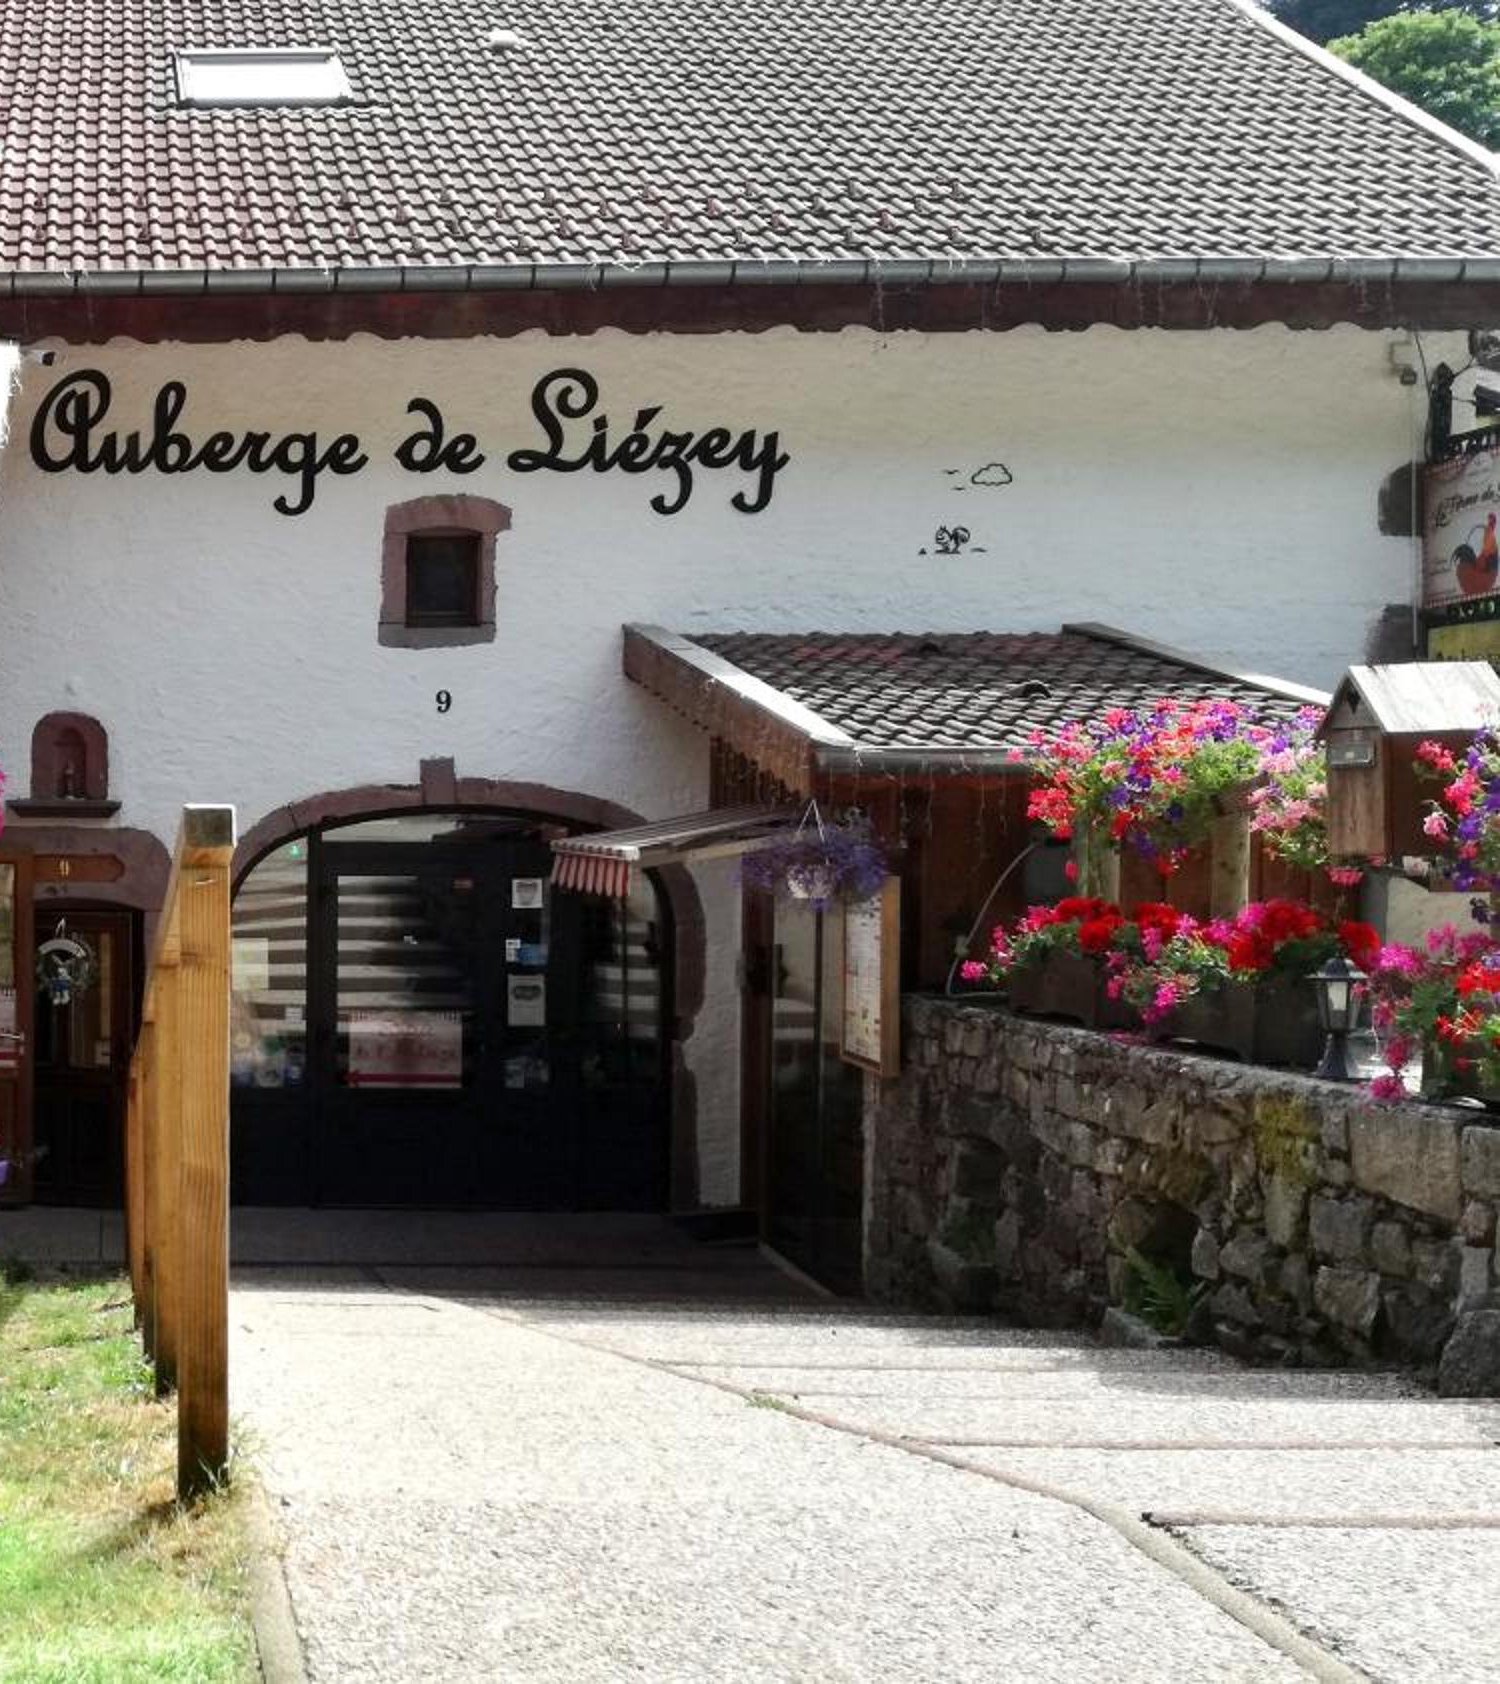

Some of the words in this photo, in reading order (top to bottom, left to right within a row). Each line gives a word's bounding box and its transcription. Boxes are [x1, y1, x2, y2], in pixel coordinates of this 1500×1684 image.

[30, 369, 368, 516] Auberge
[395, 398, 485, 474] de
[508, 368, 790, 514] Liézey
[436, 691, 451, 713] 9
